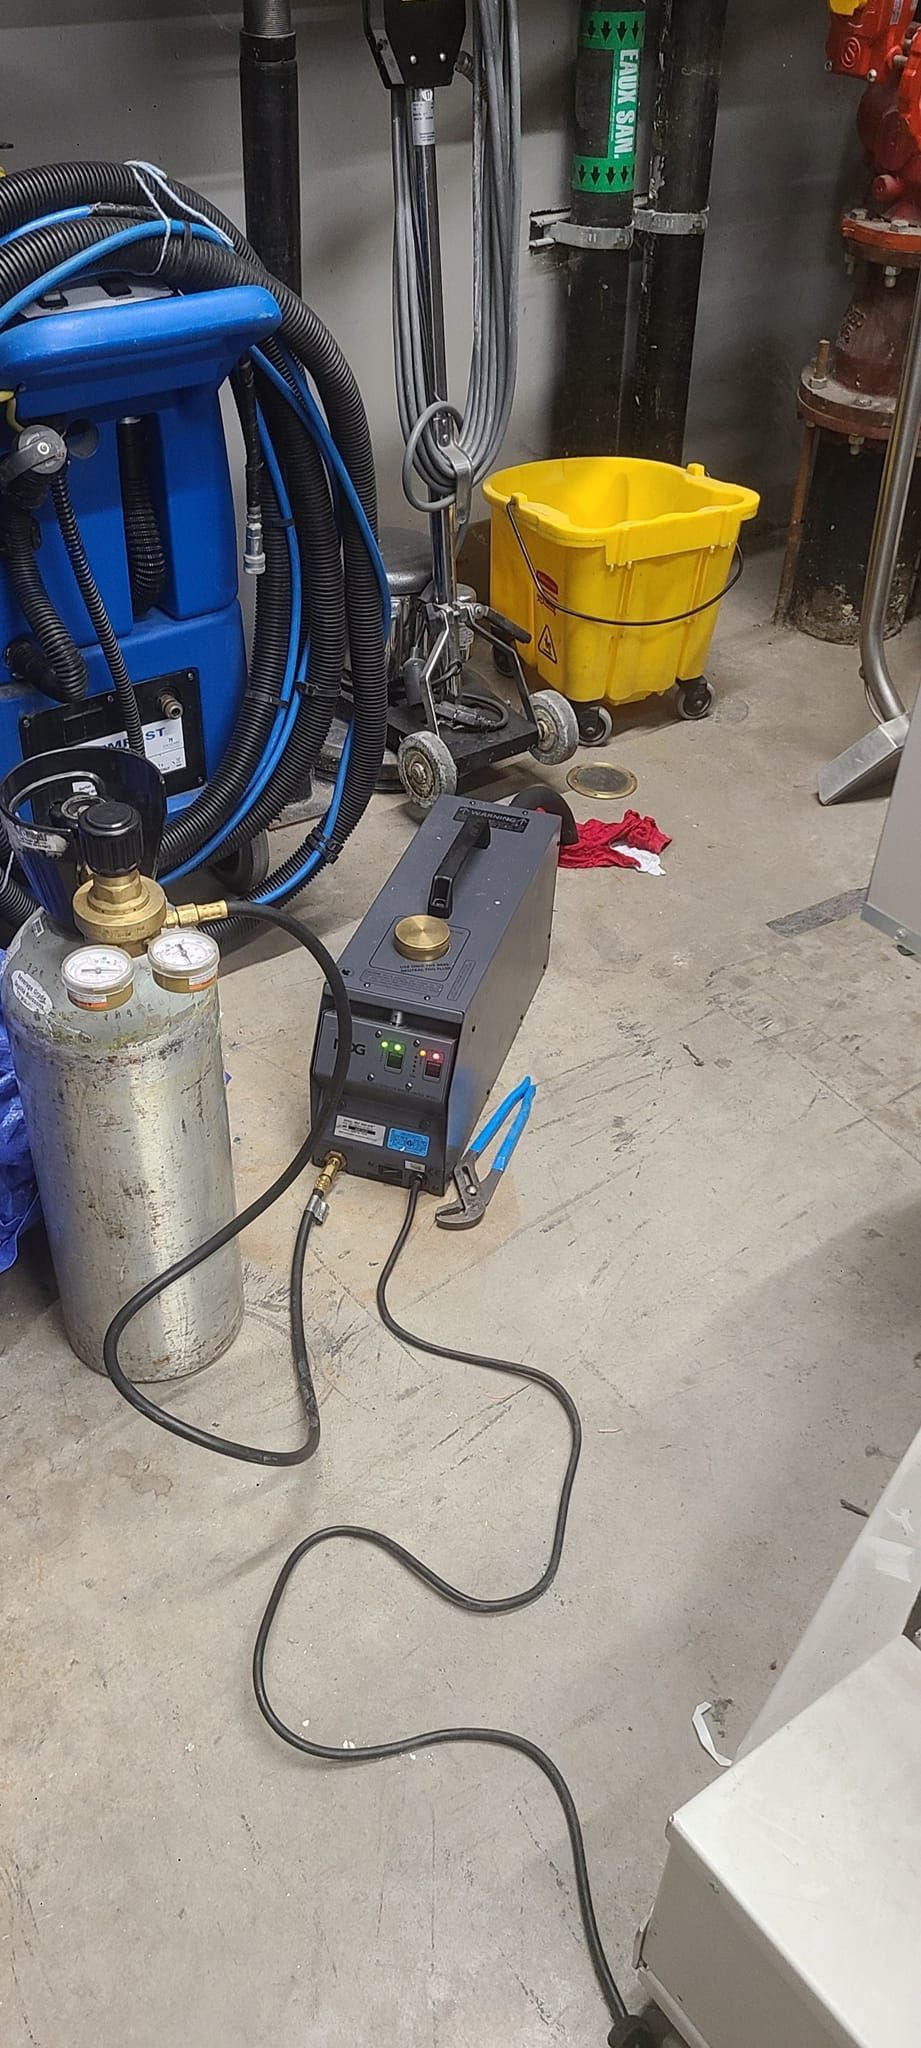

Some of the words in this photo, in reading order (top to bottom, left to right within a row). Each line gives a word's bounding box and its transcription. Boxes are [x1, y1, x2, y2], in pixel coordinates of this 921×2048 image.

[617, 49, 639, 104] EAUX
[613, 109, 636, 159] SAN.
[471, 810, 517, 824] WARNING
